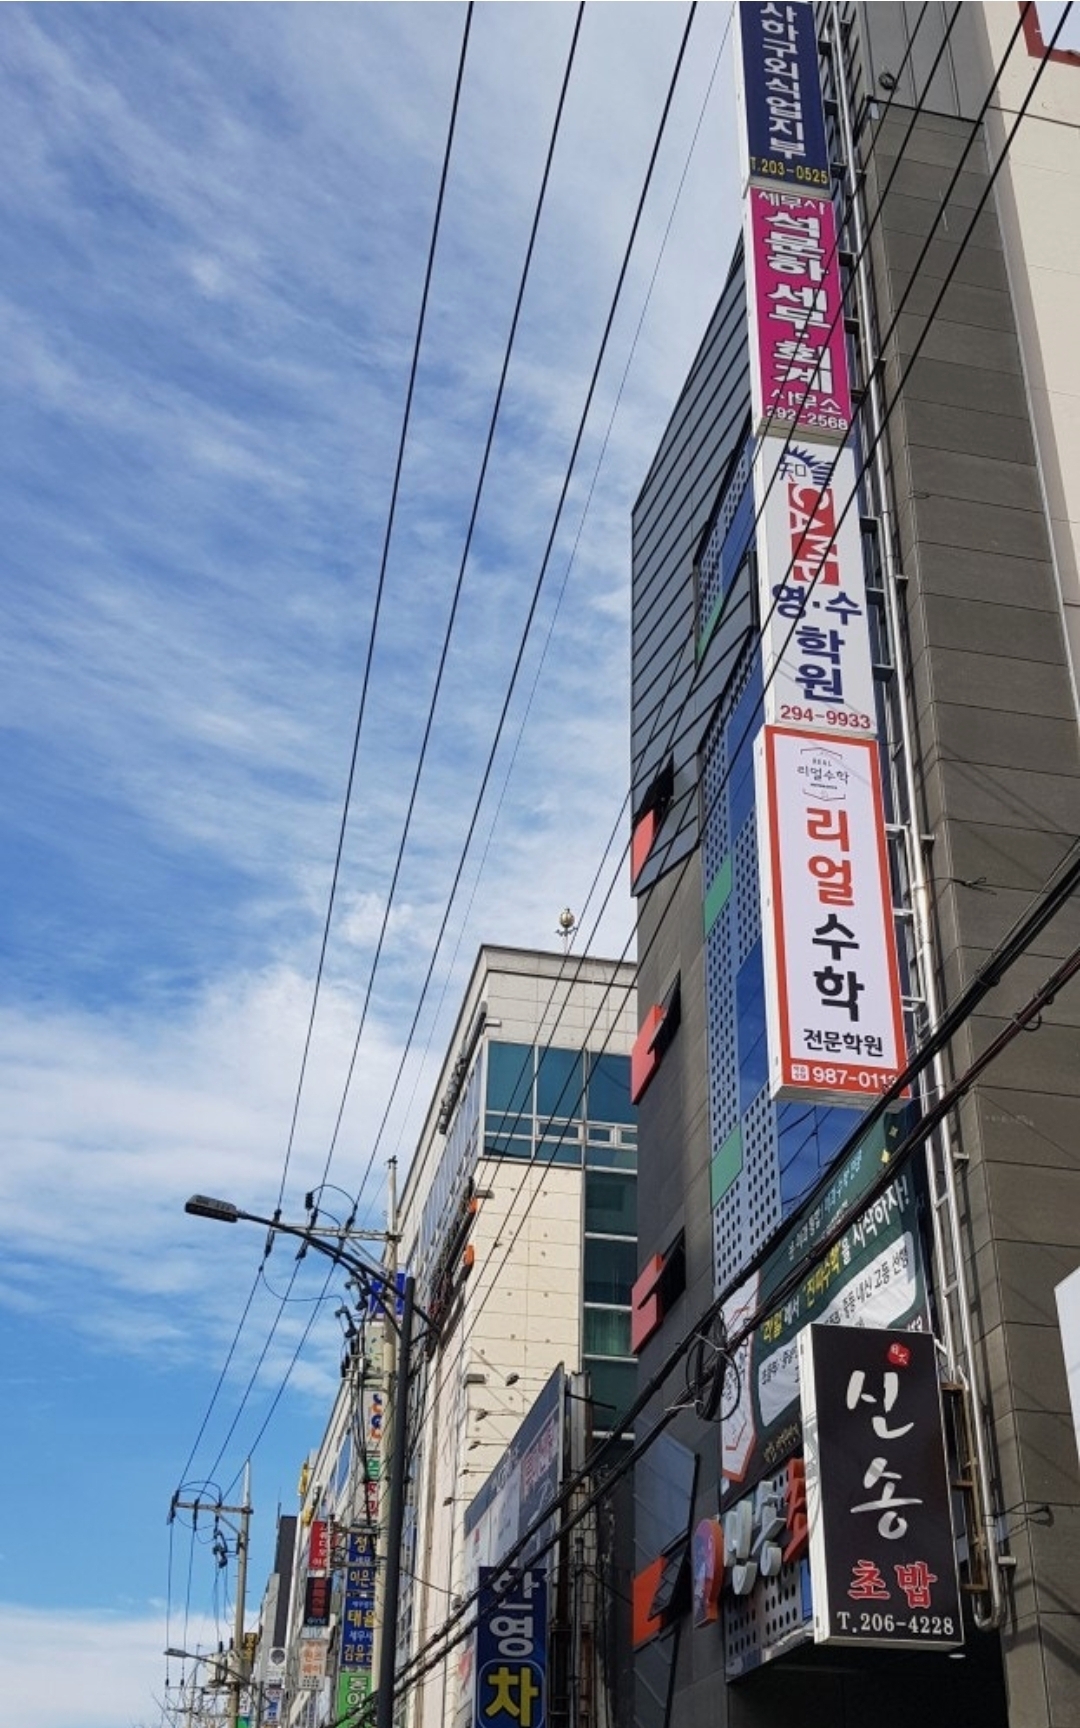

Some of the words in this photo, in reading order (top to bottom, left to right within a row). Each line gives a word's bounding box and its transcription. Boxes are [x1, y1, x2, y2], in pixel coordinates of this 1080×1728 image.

[750, 157, 828, 184] T.203-0525
[759, 191, 825, 215] 세무사
[770, 389, 842, 415] 사무소
[795, 625, 846, 704] 학원
[780, 705, 871, 729] 294-9933
[797, 765, 850, 785] 리얼수학
[803, 1028, 884, 1057] 전문학원
[847, 1369, 923, 1540] 신송
[847, 1559, 938, 1609] 초밥
[837, 1611, 954, 1635] T.206-4228
[485, 1667, 539, 1727] 차
